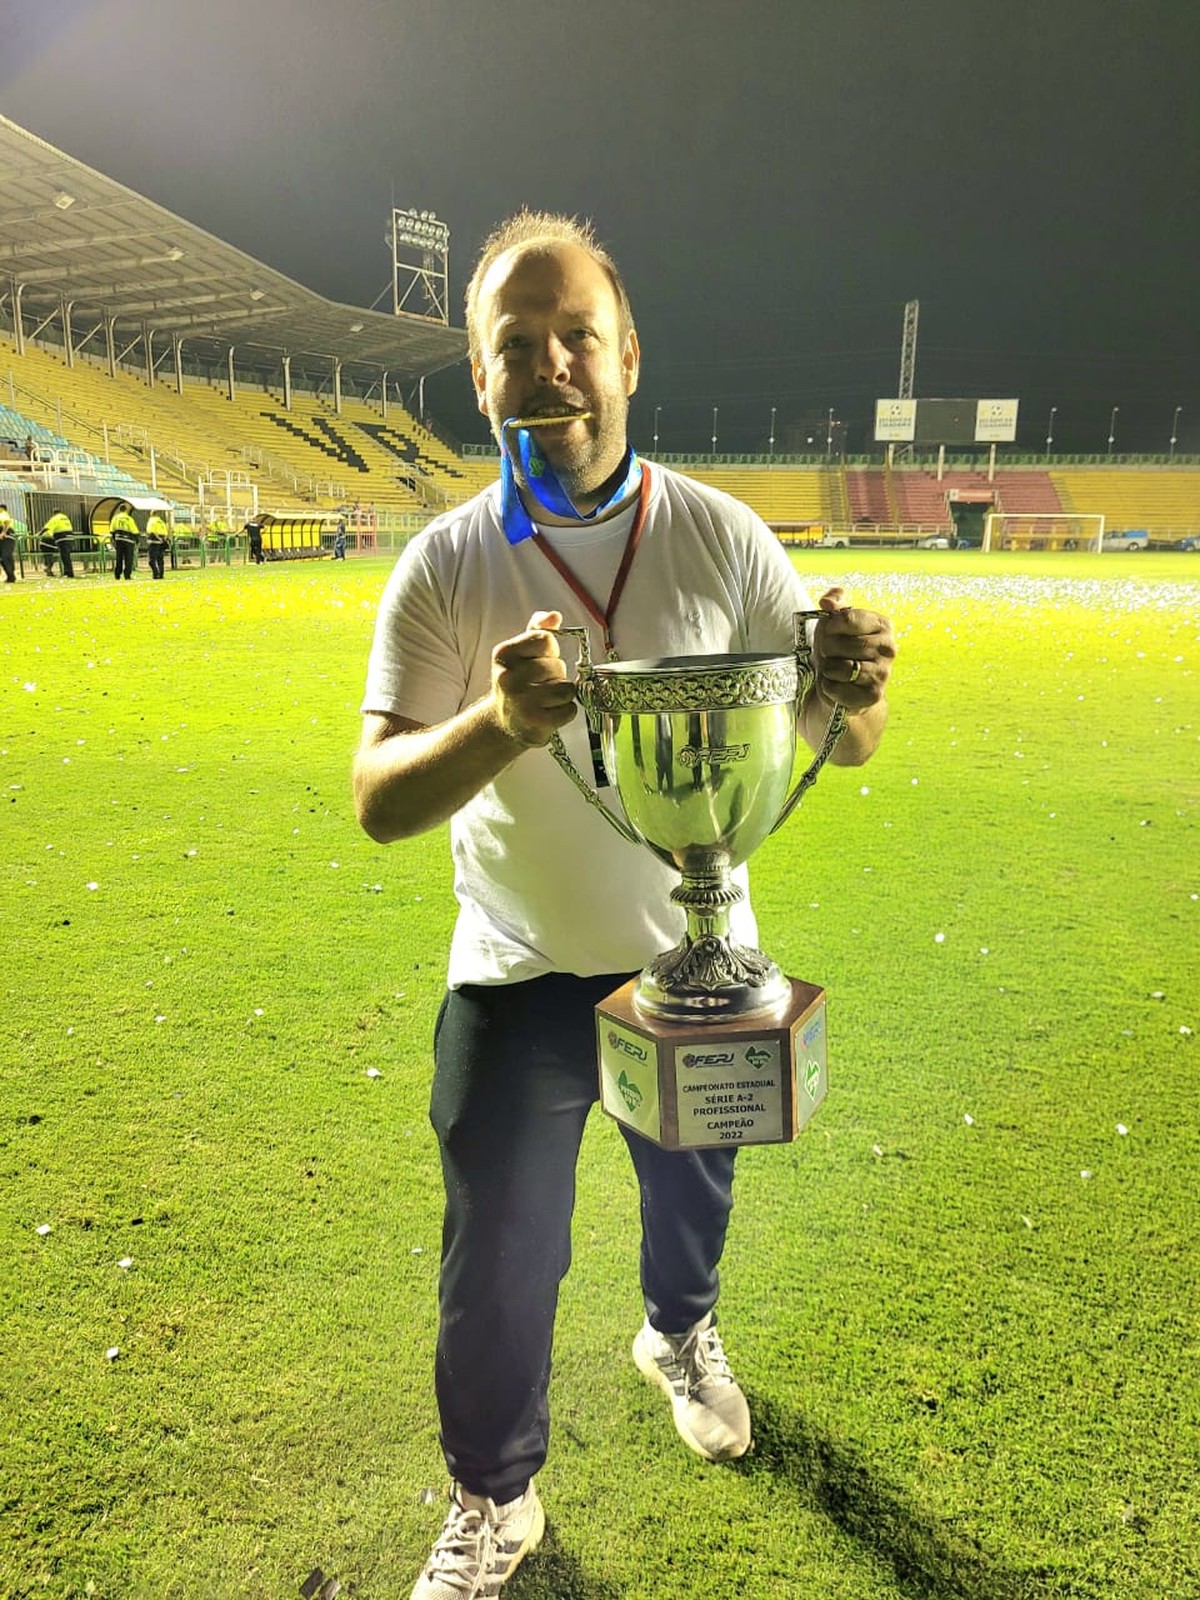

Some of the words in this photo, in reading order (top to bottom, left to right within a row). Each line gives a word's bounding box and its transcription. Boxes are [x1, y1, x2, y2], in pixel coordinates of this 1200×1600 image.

[616, 1037, 648, 1062] FERJ
[694, 1053, 735, 1065] FERJ
[683, 1082, 735, 1093] CAMPEONATO
[736, 1079, 775, 1089] ESTADUAL
[705, 1093, 735, 1104] SÉRIE
[737, 1093, 754, 1102] A-2
[693, 1103, 766, 1116] PROFISSIONAL
[707, 1117, 754, 1130] CAMPEÃO
[719, 1131, 743, 1140] 2022
